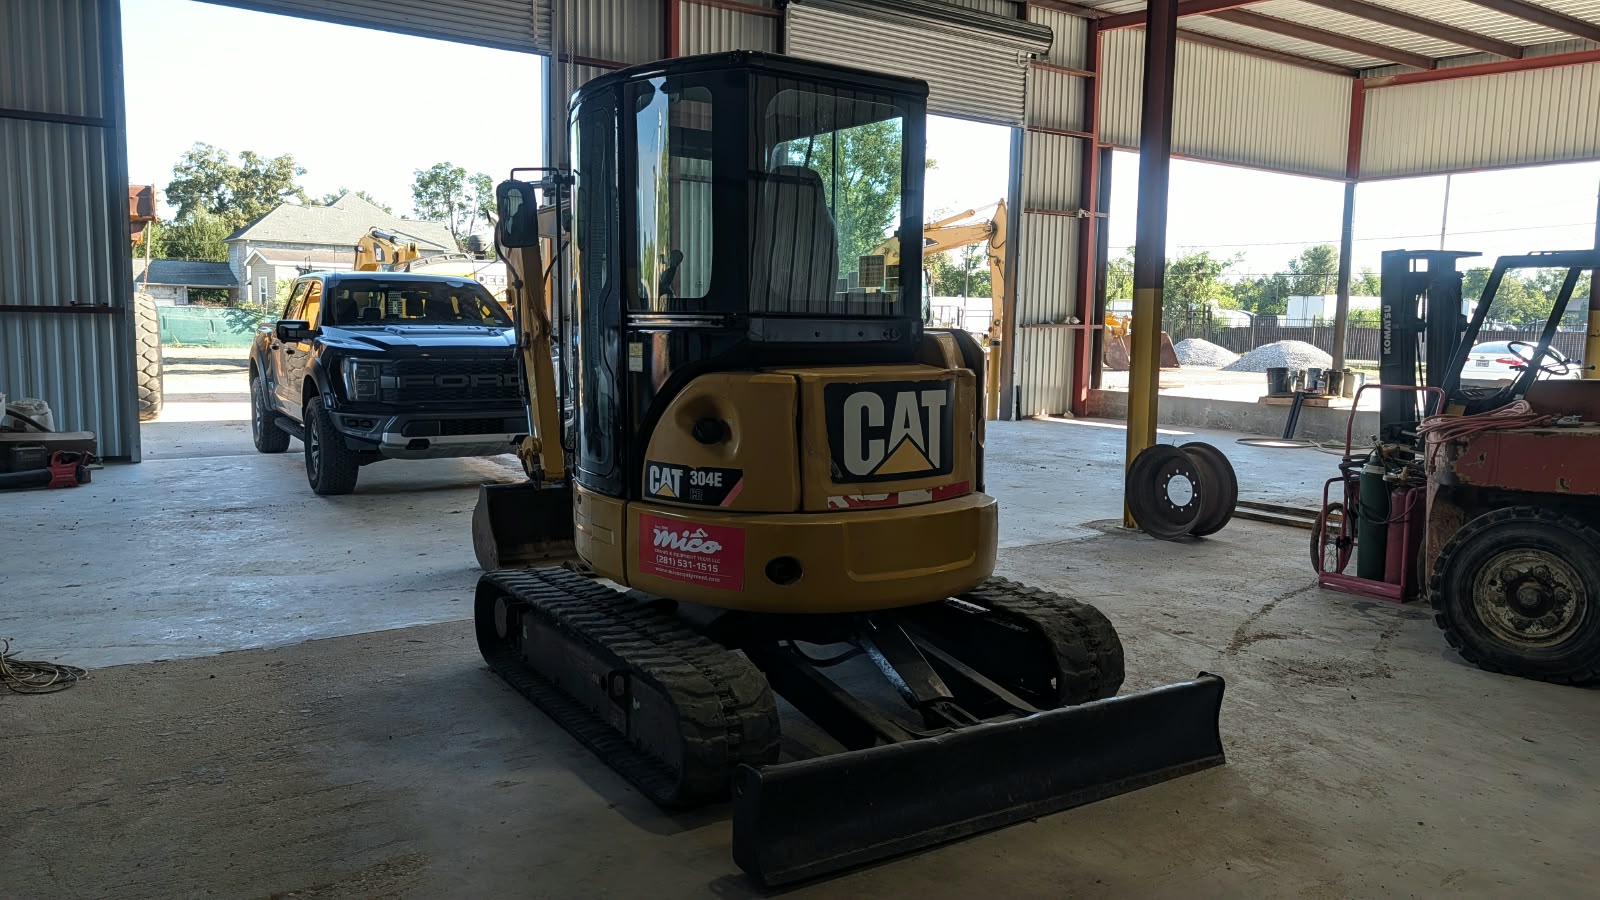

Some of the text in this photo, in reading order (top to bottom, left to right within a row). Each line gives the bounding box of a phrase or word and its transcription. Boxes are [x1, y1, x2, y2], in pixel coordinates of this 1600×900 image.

[477, 273, 507, 286] DEE
[1383, 304, 1392, 355] KOMATSU
[843, 389, 947, 476] CAT
[649, 465, 723, 498] CAT 304E
[656, 554, 719, 573] (281) 531-1515
